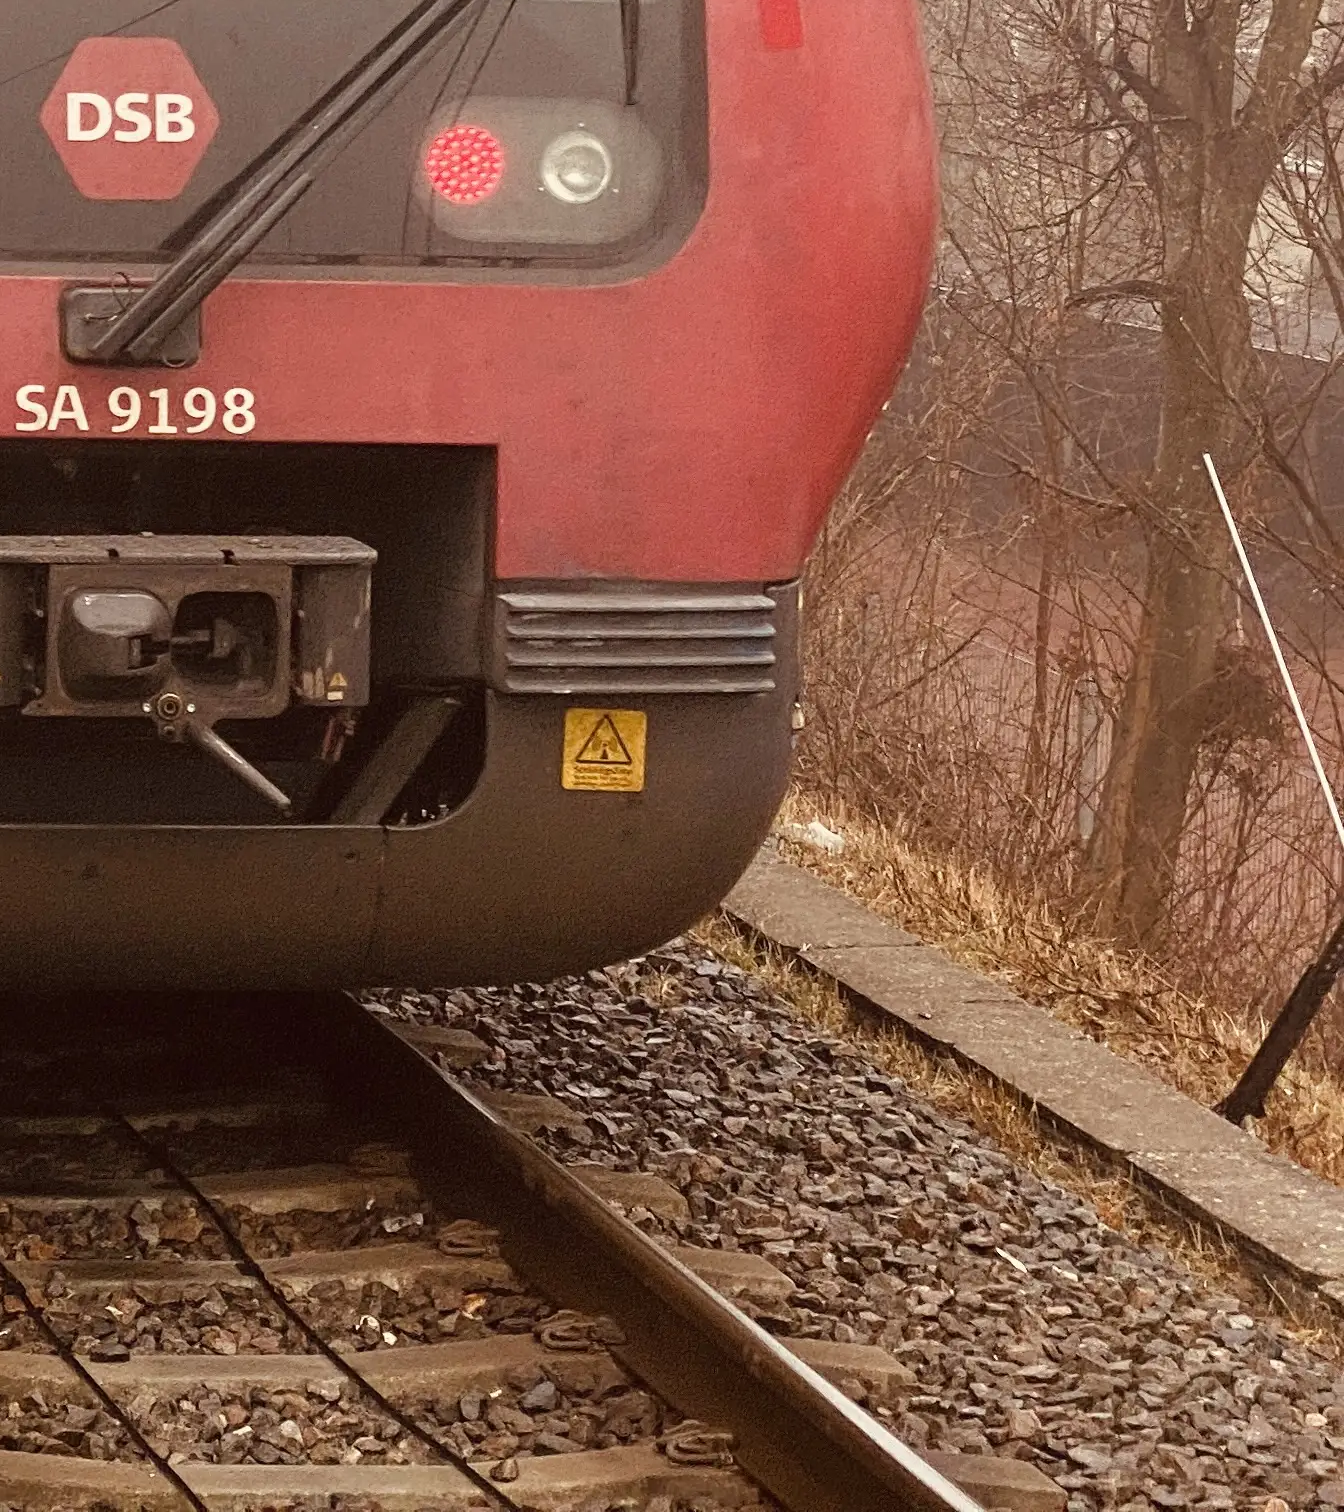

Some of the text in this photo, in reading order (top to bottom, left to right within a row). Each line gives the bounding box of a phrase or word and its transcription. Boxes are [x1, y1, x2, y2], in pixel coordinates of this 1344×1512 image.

[66, 92, 196, 143] DSB
[15, 384, 256, 435] SA 9198
